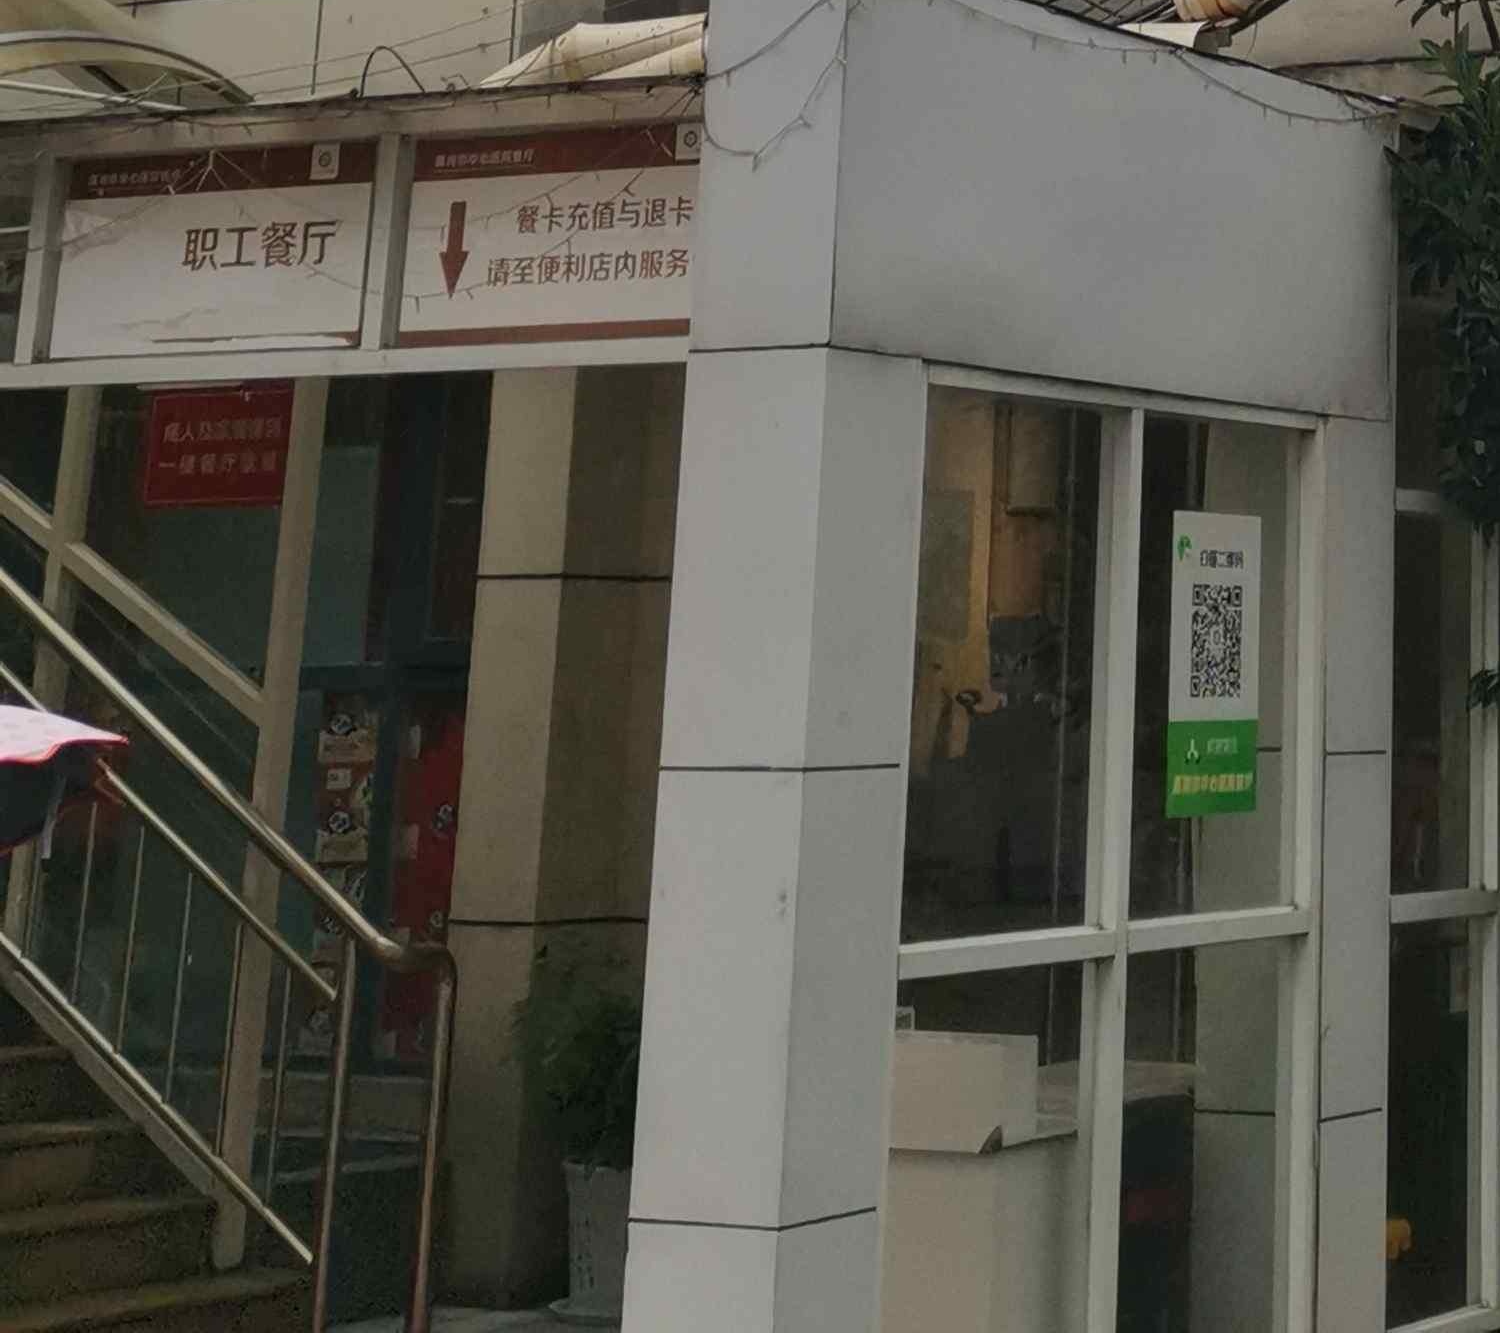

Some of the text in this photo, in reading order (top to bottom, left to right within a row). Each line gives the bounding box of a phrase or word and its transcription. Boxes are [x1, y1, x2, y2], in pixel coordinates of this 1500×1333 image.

[517, 196, 694, 233] 餐卡充值与退卡
[182, 220, 338, 271] 职工餐厅
[486, 249, 689, 285] 请至便利店内服务
